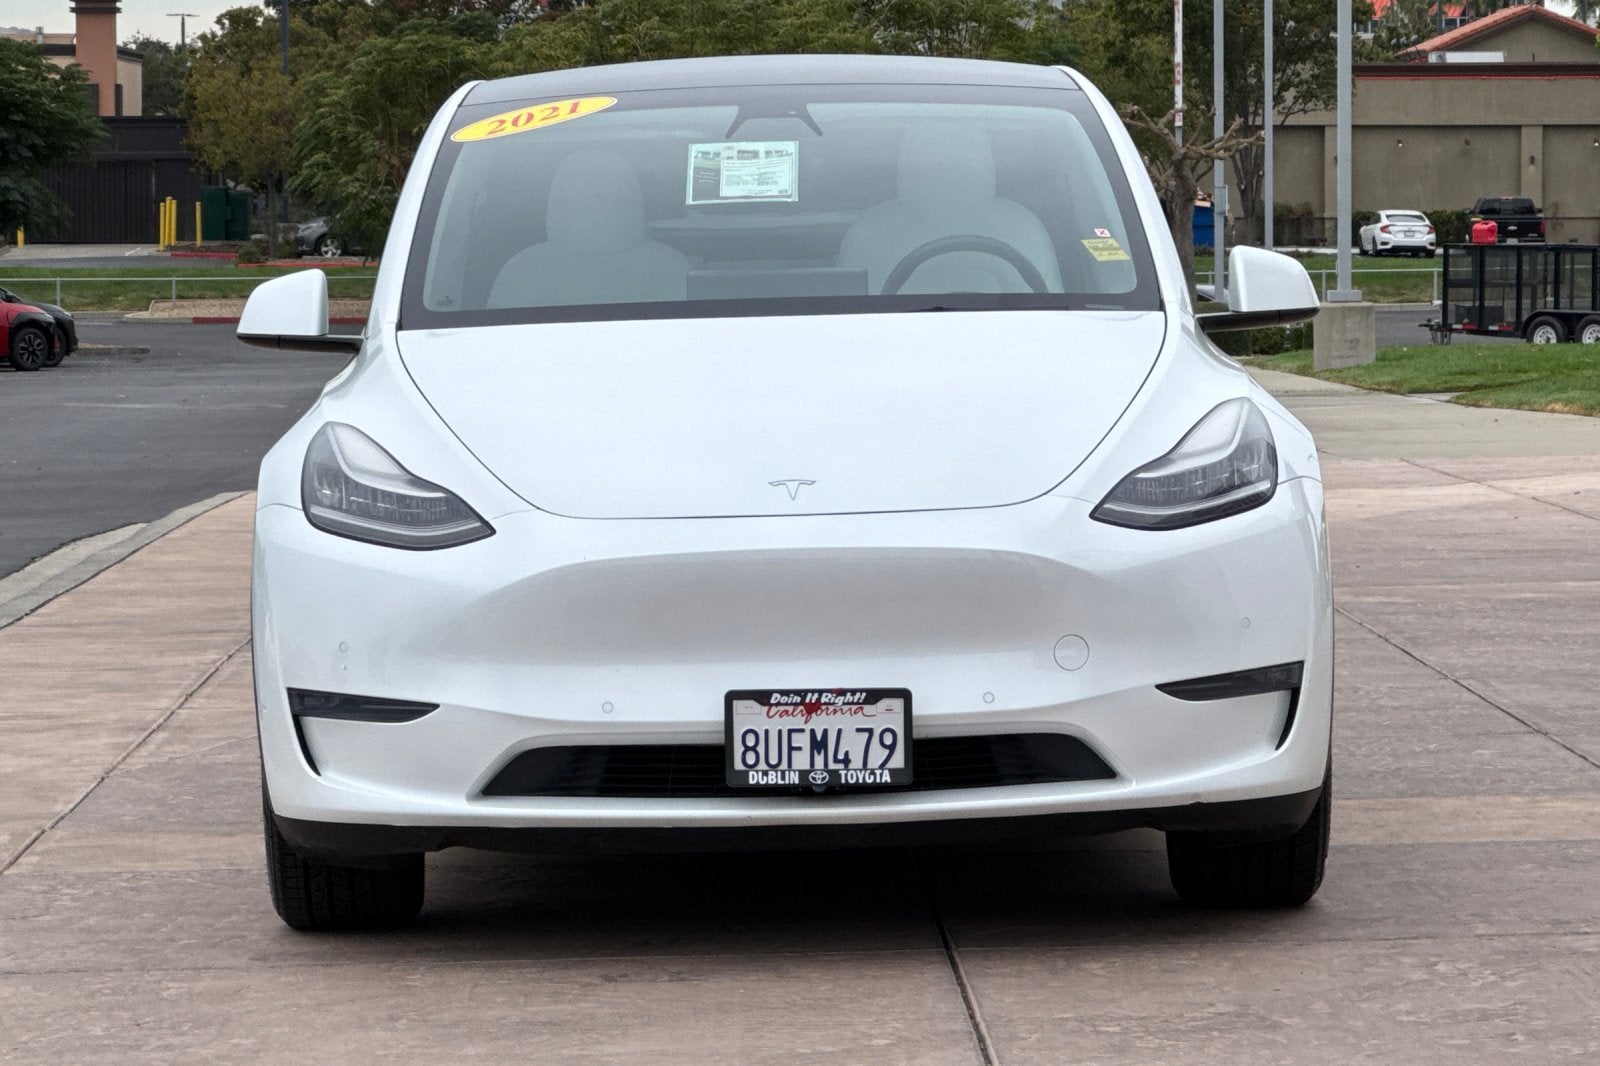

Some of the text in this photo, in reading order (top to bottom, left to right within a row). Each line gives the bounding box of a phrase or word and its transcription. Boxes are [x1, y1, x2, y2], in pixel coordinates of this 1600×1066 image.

[485, 101, 581, 136] 2021
[805, 692, 820, 703] It
[820, 692, 867, 707] Right!
[741, 727, 898, 769] 8UFM479
[749, 769, 891, 784] DUBLIN TOYOTA
